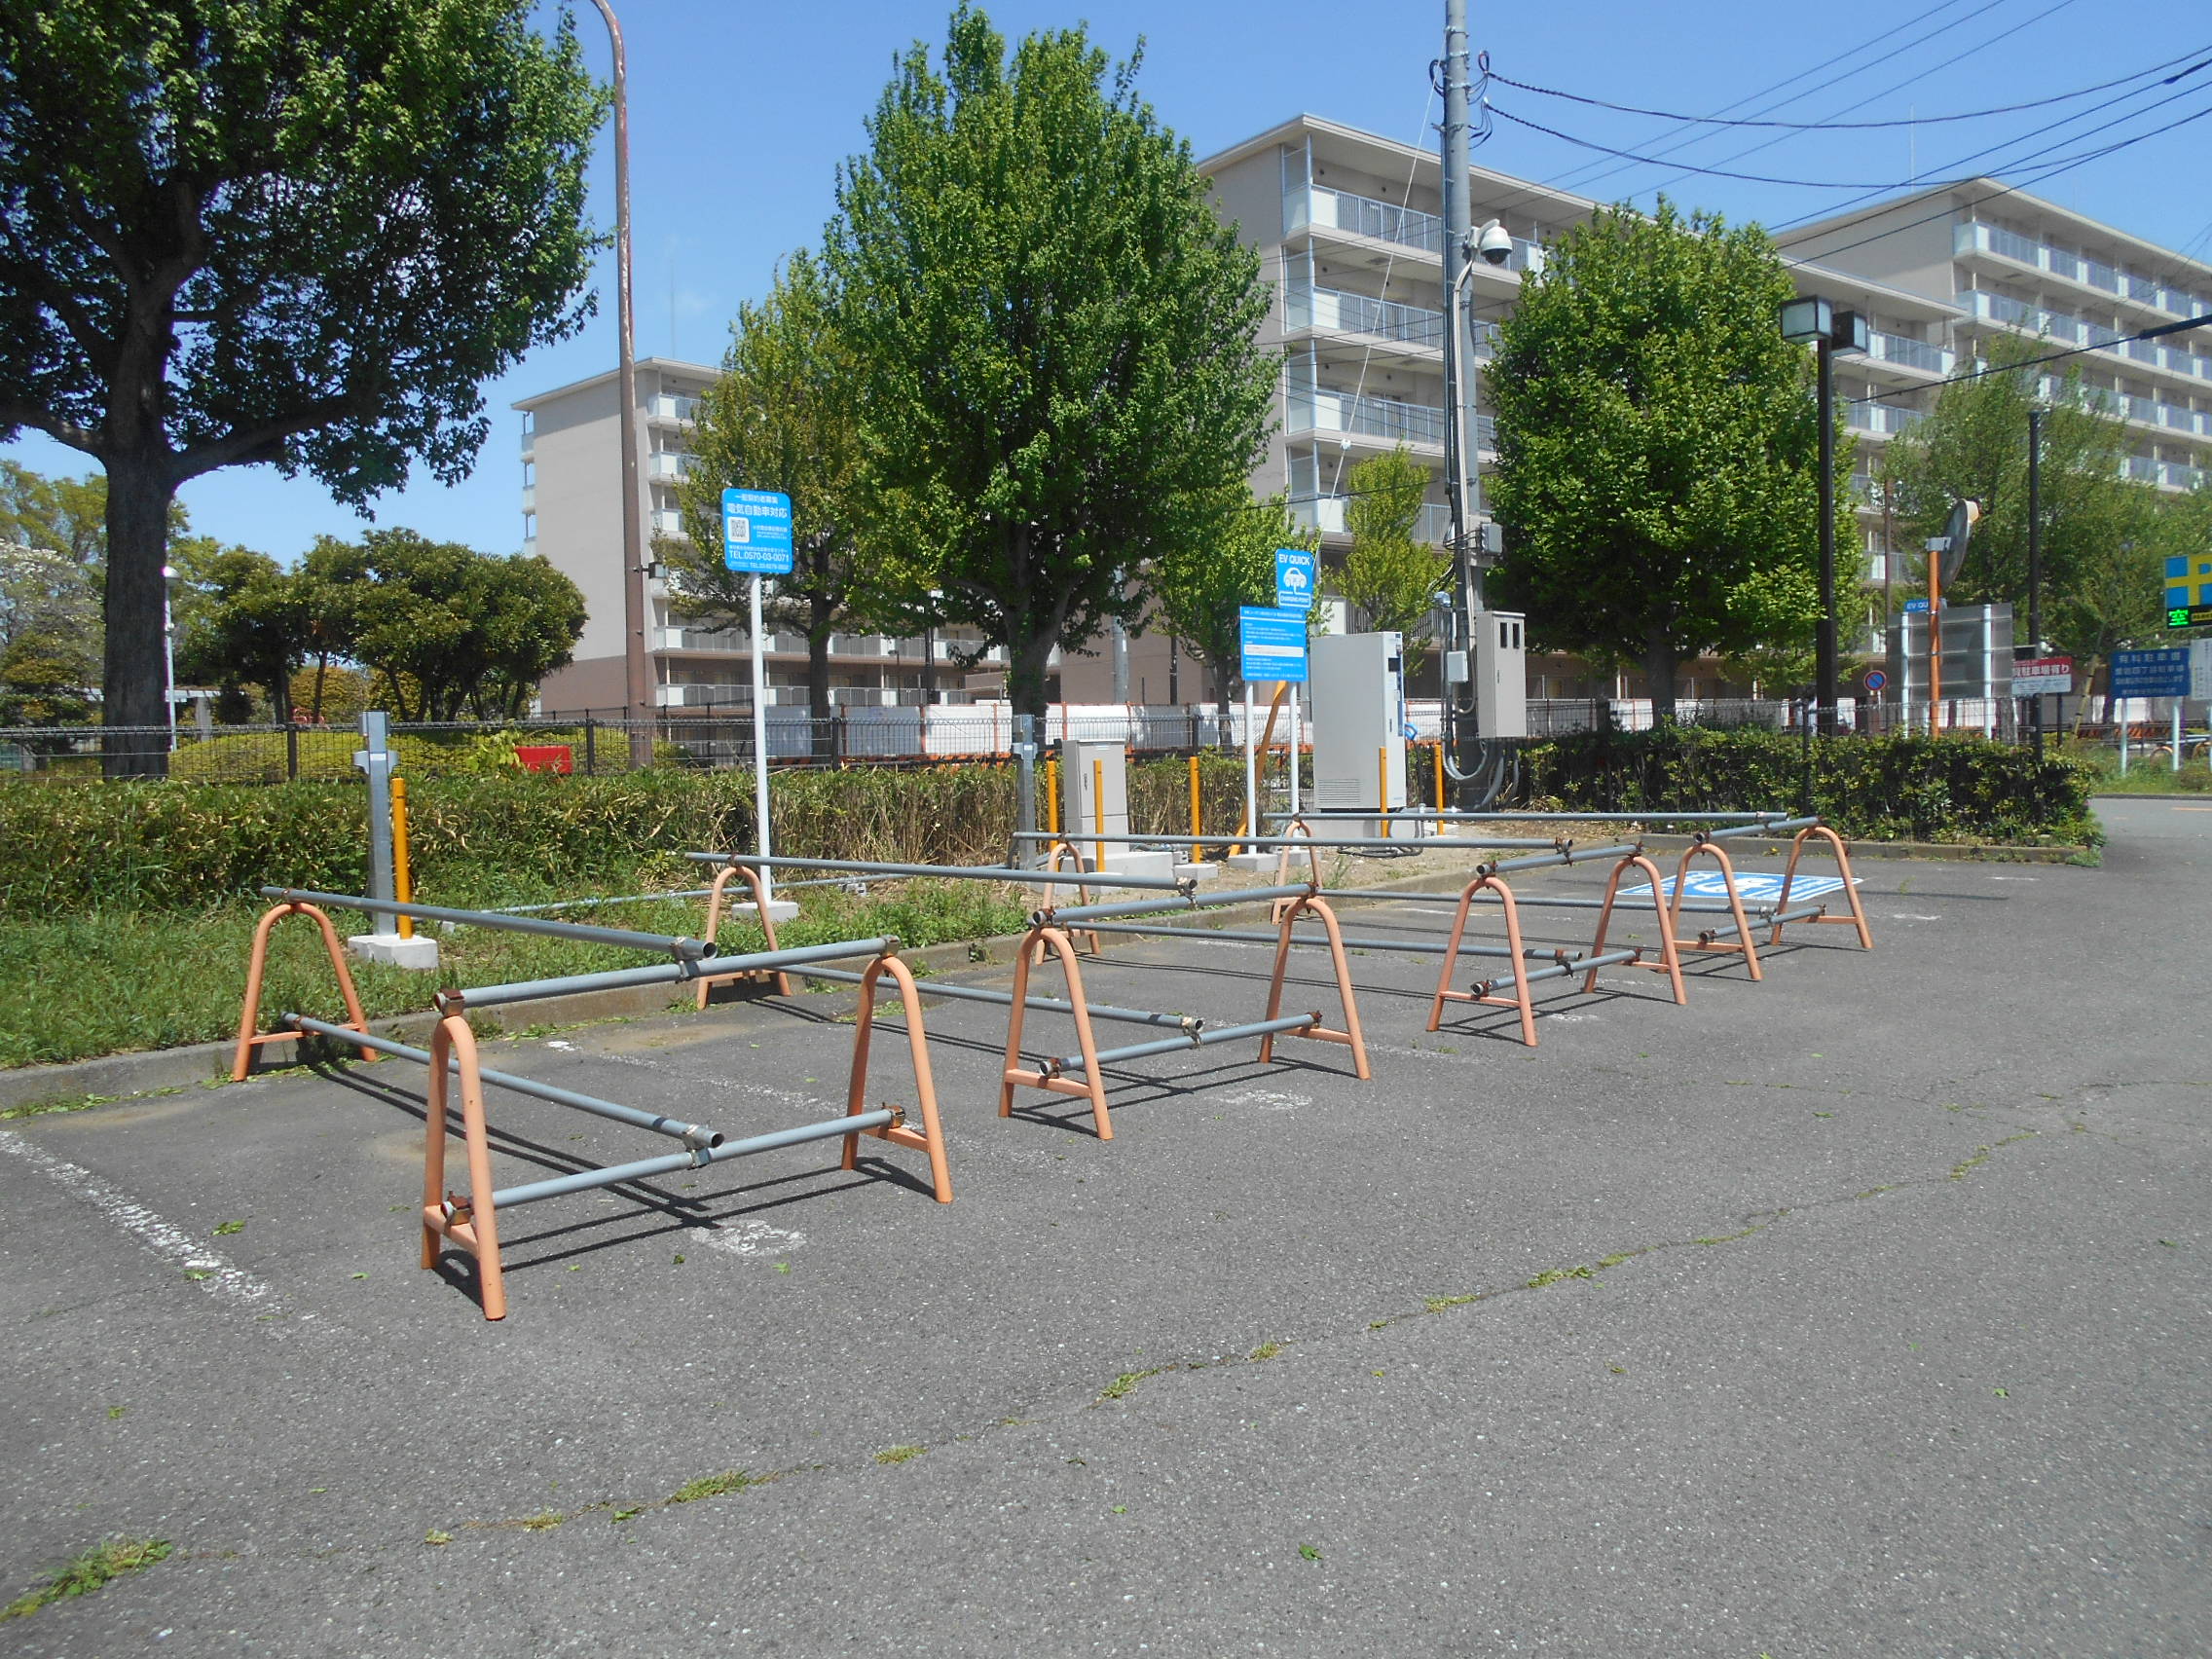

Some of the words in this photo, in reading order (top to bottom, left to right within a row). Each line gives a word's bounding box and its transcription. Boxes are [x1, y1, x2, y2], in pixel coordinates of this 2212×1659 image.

[727, 503, 788, 518] 電気自動車対応
[1278, 553, 1288, 564] EV
[1289, 554, 1310, 566] QUICK
